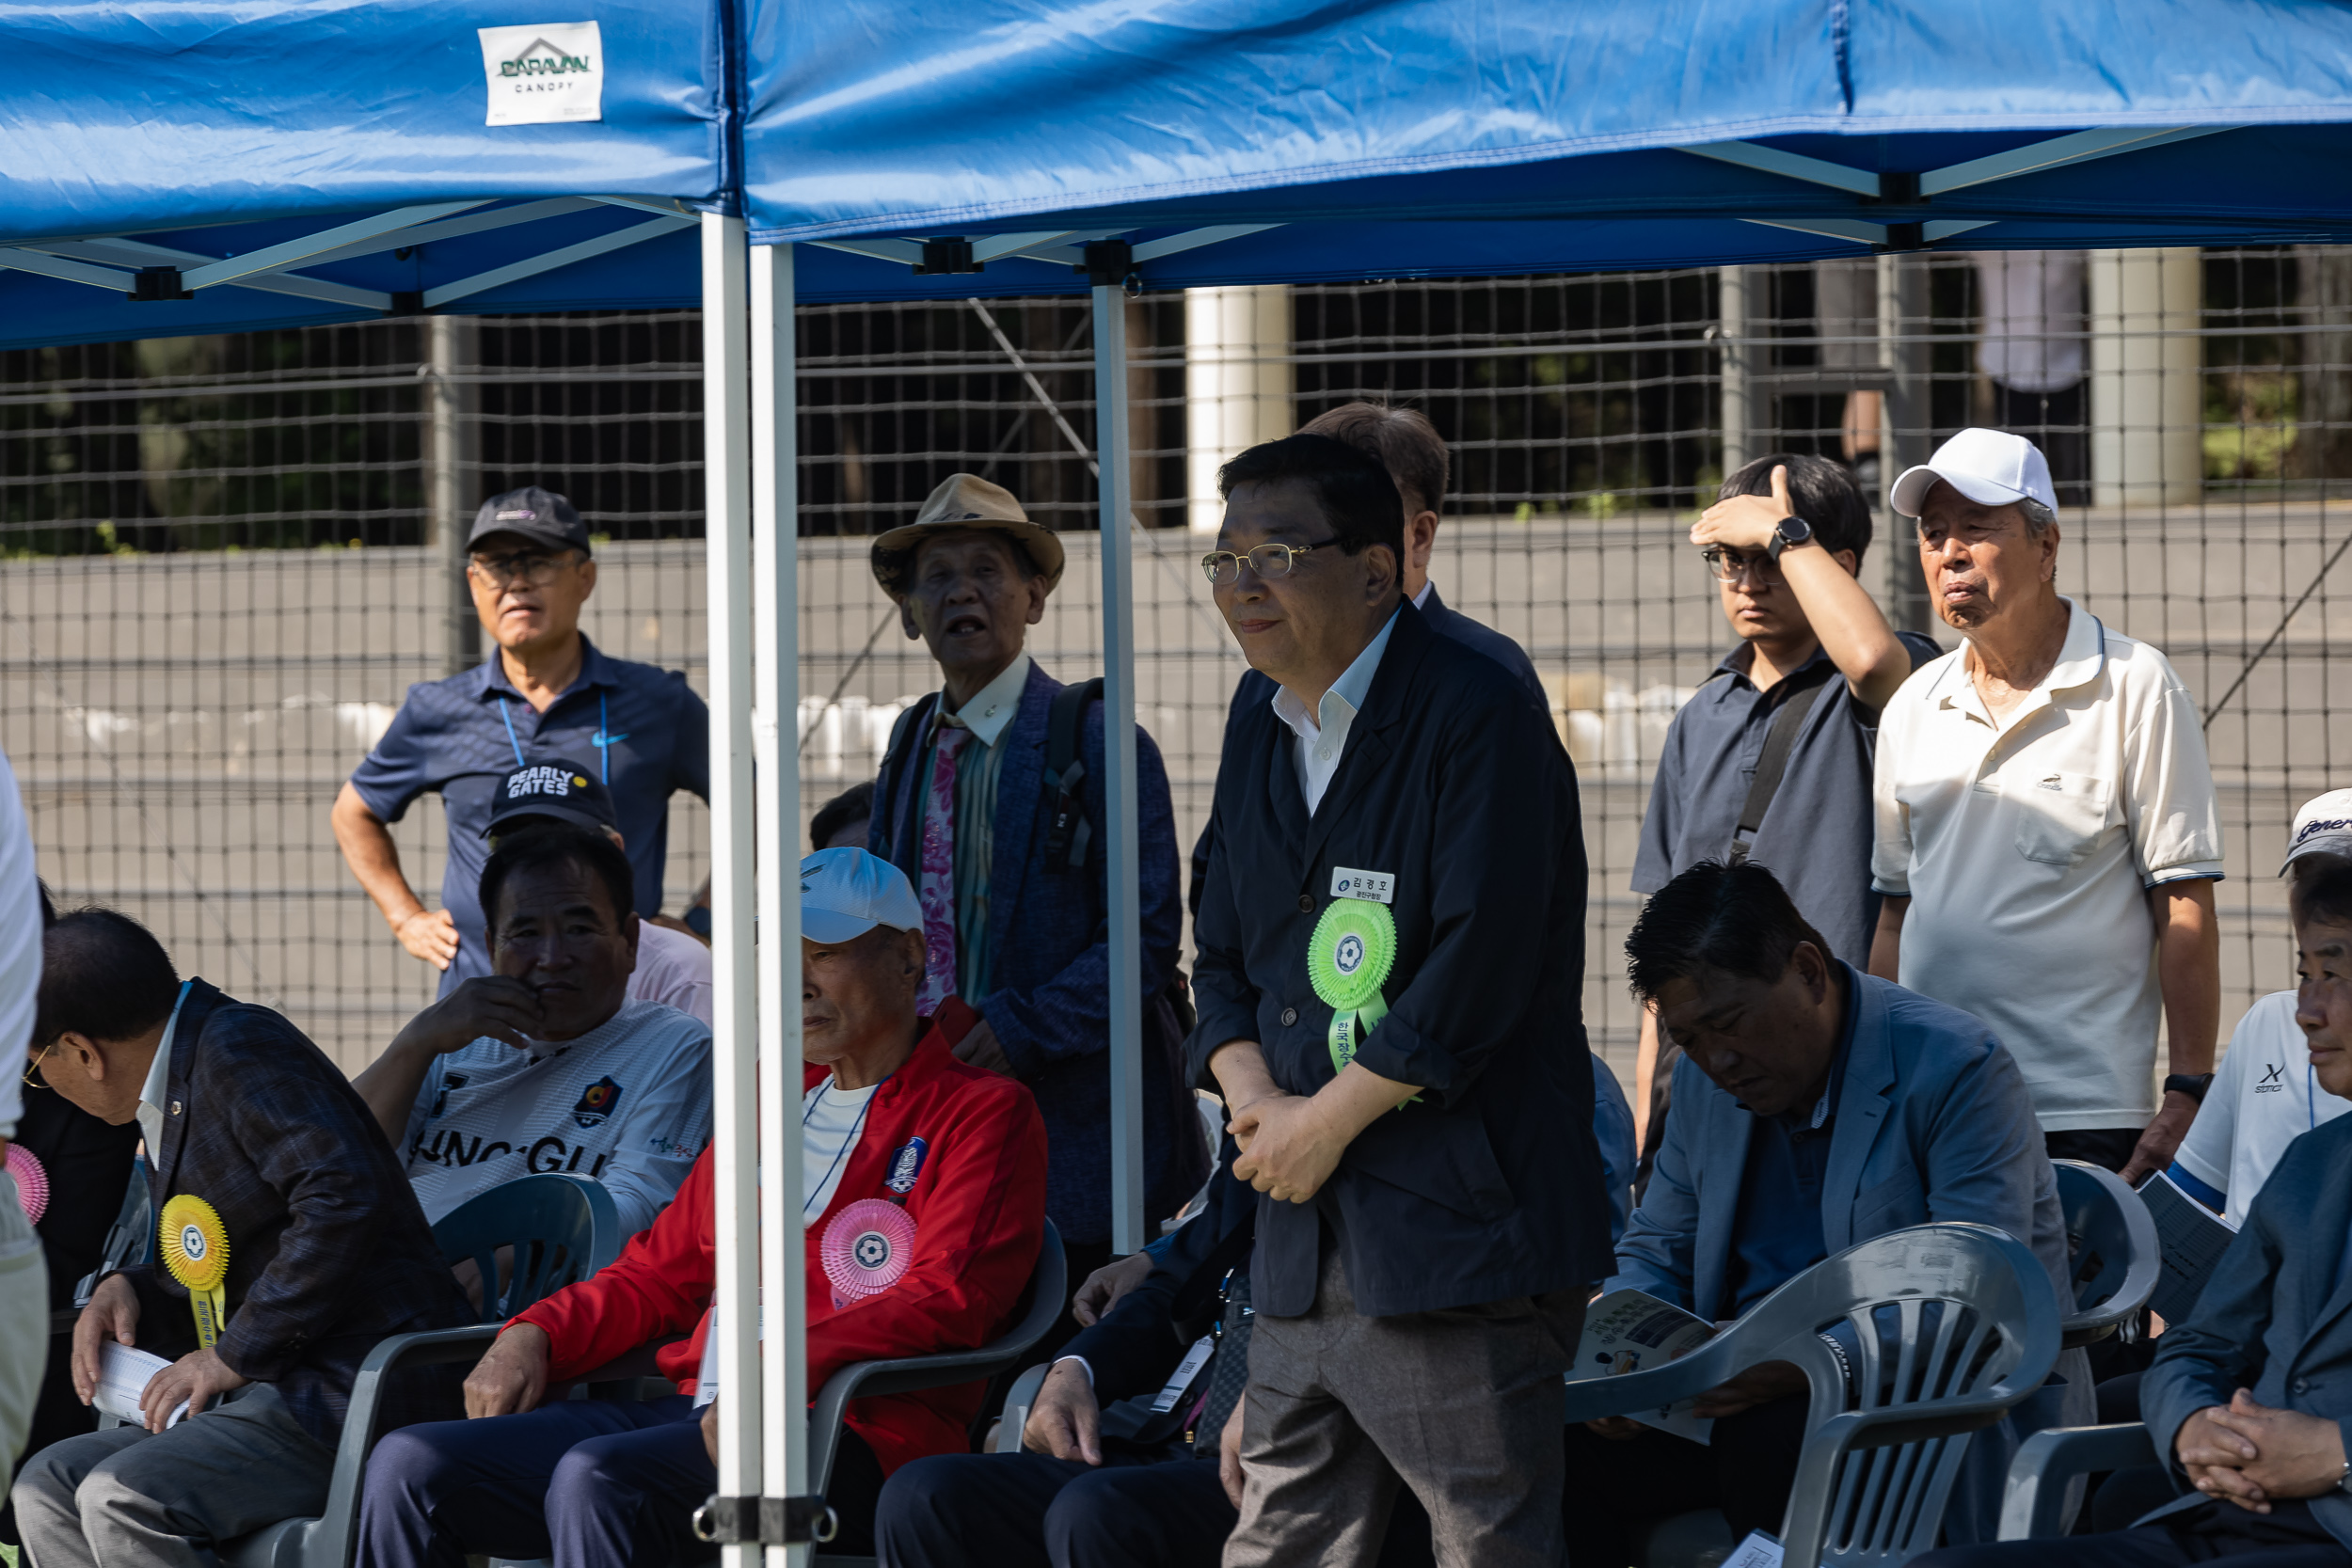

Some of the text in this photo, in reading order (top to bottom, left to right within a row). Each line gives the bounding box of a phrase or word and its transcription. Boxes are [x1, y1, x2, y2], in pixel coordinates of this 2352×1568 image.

[515, 81, 574, 93] CANOPY
[507, 766, 575, 789] PEARLY
[508, 779, 569, 799] GATES
